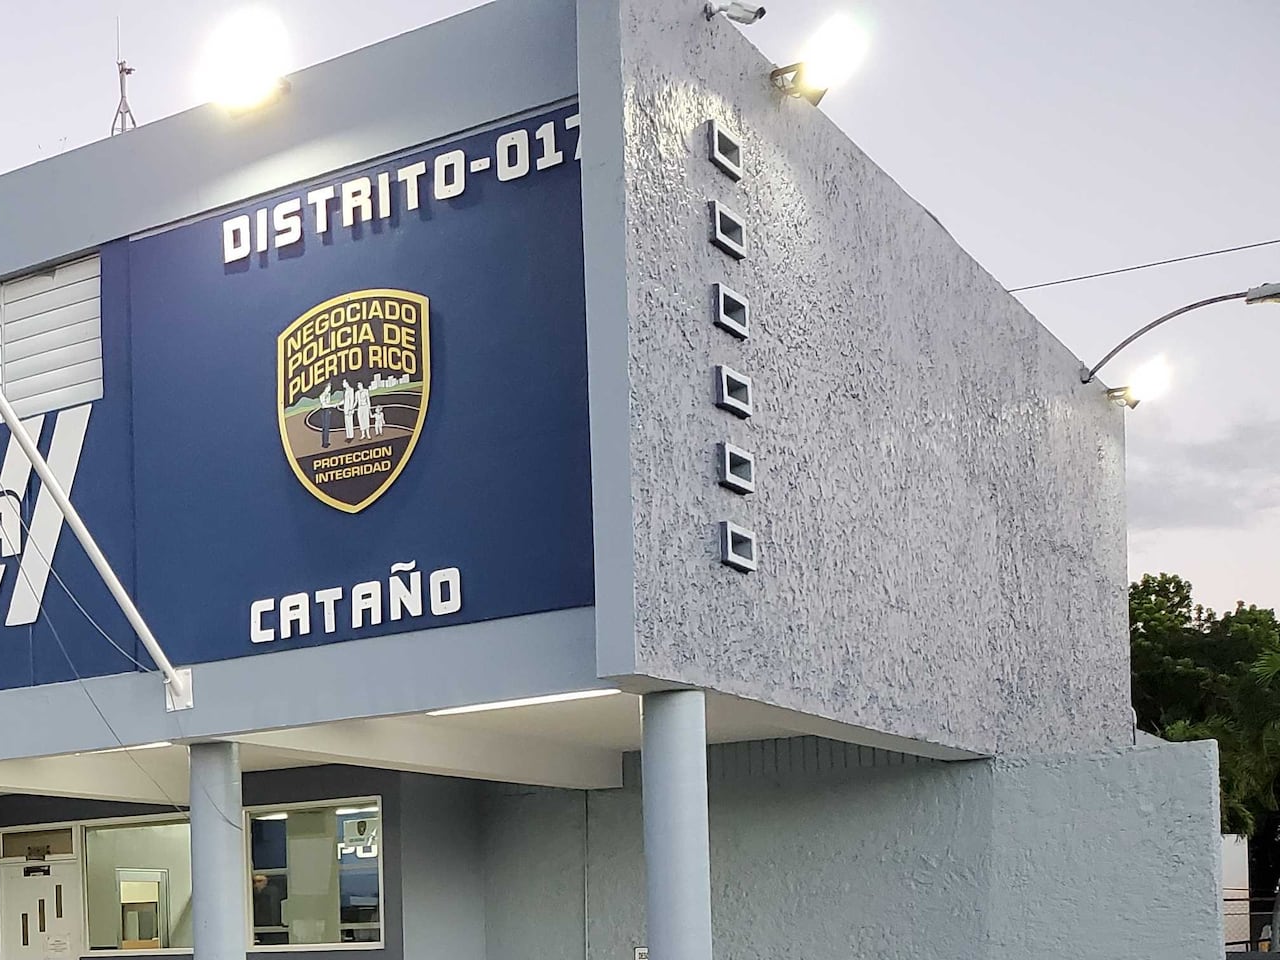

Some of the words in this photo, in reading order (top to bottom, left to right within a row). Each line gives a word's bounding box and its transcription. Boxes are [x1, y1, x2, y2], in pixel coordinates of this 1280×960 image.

[286, 300, 417, 358] NEGOCIADO
[288, 322, 375, 379] POLICIA
[383, 322, 417, 351] DE
[288, 346, 363, 404] PUERTO
[368, 345, 417, 375] RICO
[312, 445, 393, 471] PROTECCION
[315, 459, 392, 484] INTEGRIDAD
[249, 559, 461, 644] CATAÑO
